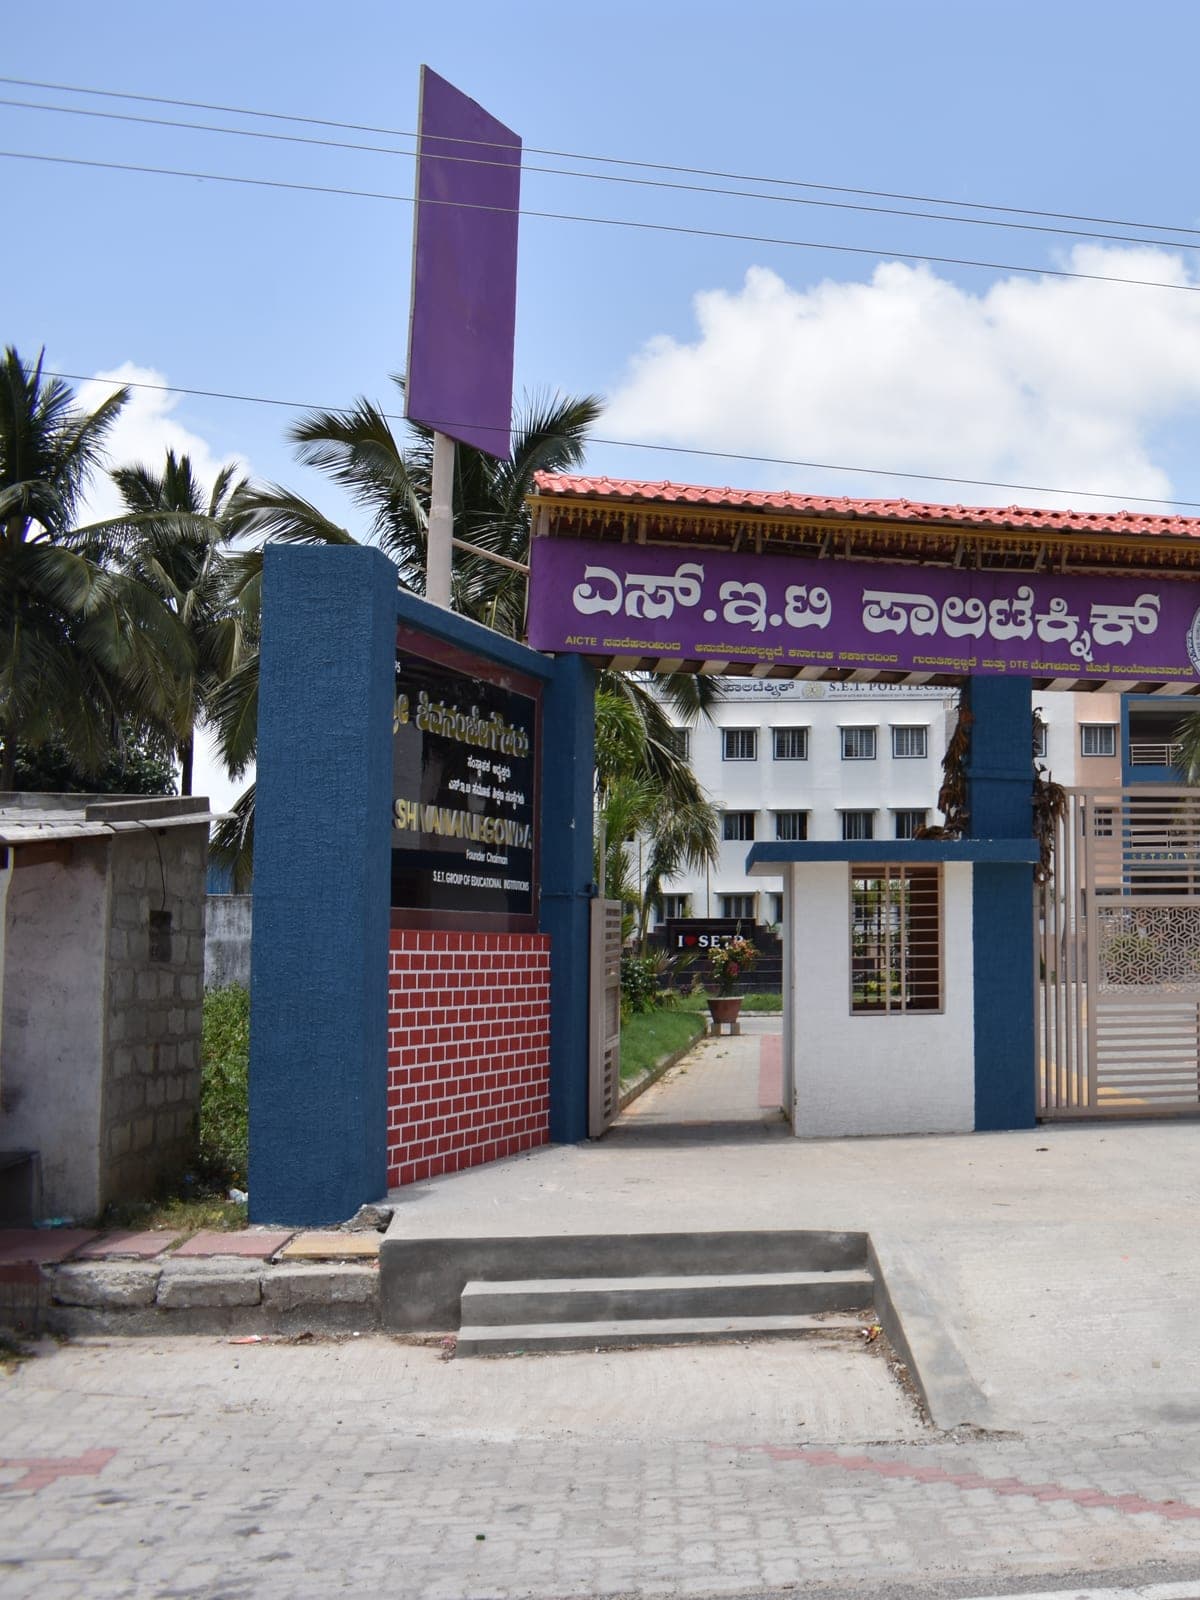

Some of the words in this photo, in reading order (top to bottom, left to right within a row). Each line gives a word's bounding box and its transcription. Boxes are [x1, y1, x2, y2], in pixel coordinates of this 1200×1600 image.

[572, 562, 832, 633] ಎಸ್.ಇ.ಟಿ
[862, 585, 1160, 662] ಪಾಲಿಟೆಕ್ನಿಕ್
[565, 635, 597, 647] AICTE
[1010, 661, 1028, 669] DTE
[466, 849, 485, 862] Founder
[446, 871, 463, 886] GROUP
[464, 874, 471, 886] OF
[471, 874, 502, 888] EDUCATIONAL
[678, 935, 684, 948] I
